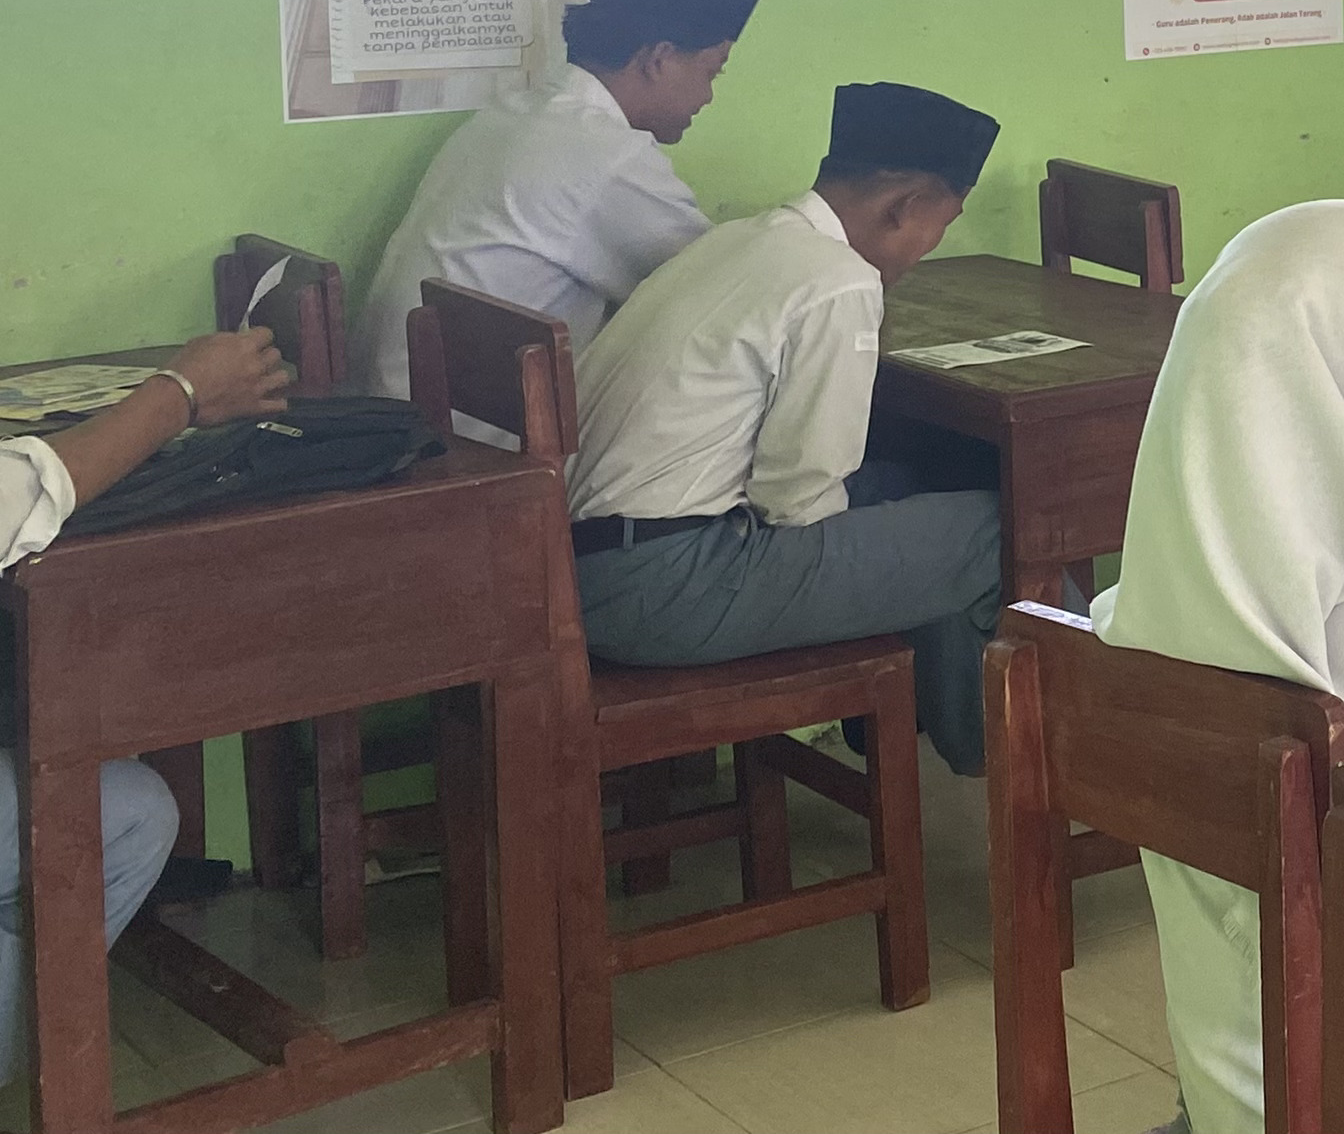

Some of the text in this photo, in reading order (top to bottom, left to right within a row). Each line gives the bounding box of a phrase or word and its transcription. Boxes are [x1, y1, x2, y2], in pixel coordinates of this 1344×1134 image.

[370, 1, 514, 16] kebebasan untuk
[374, 12, 512, 28] melakukan atau
[369, 24, 516, 40] meninggalkannya
[364, 35, 524, 53] tanpa pembalasan
